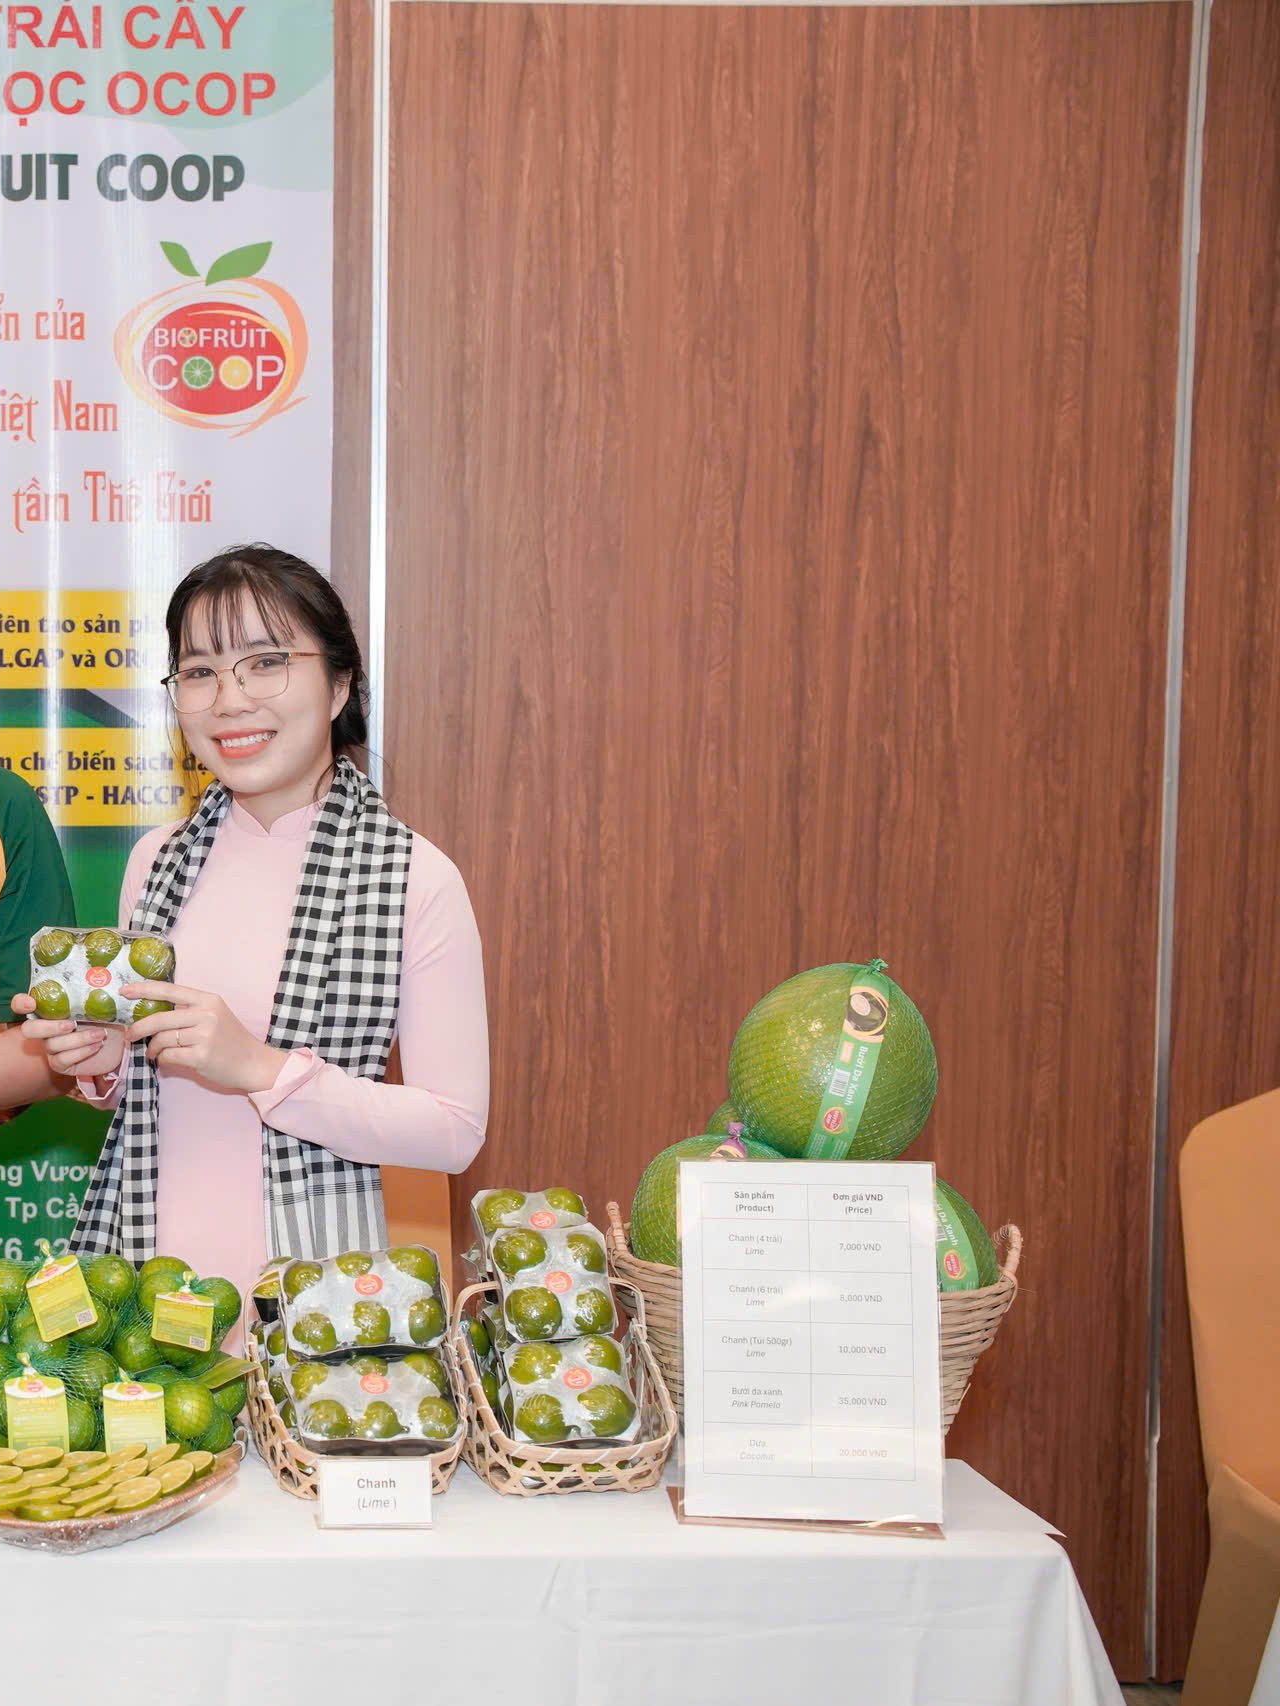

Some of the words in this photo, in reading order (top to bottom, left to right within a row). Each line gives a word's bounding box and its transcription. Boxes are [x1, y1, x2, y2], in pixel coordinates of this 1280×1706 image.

[107, 71, 276, 116] OCOP
[96, 154, 245, 202] COOP
[34, 297, 86, 341] của
[147, 354, 284, 390] COOP
[53, 379, 118, 432] Nam
[11, 477, 70, 533] tầm
[83, 613, 120, 633] sản
[72, 650, 96, 667] và
[68, 750, 115, 770] biến
[103, 786, 184, 805] HACCP
[844, 1083, 858, 1106] Xanh
[865, 1193, 883, 1201] VND
[5, 1197, 38, 1223] Tp
[735, 1203, 774, 1213] (Product)
[845, 1206, 872, 1215] (Price)
[728, 1234, 754, 1242] Chanh
[745, 1247, 765, 1255] Lime
[839, 1242, 862, 1252] 7,000
[863, 1243, 881, 1251] VND
[729, 1284, 755, 1293] Chanh
[745, 1298, 765, 1306] Lime
[721, 1336, 748, 1344] Chanh
[746, 1349, 766, 1357] Lime
[868, 1346, 886, 1354] VND
[751, 1387, 761, 1395] da
[751, 1400, 781, 1409] Pomelo
[868, 1398, 887, 1406] VND
[869, 1449, 888, 1457] VND
[356, 1478, 397, 1489] Chanh
